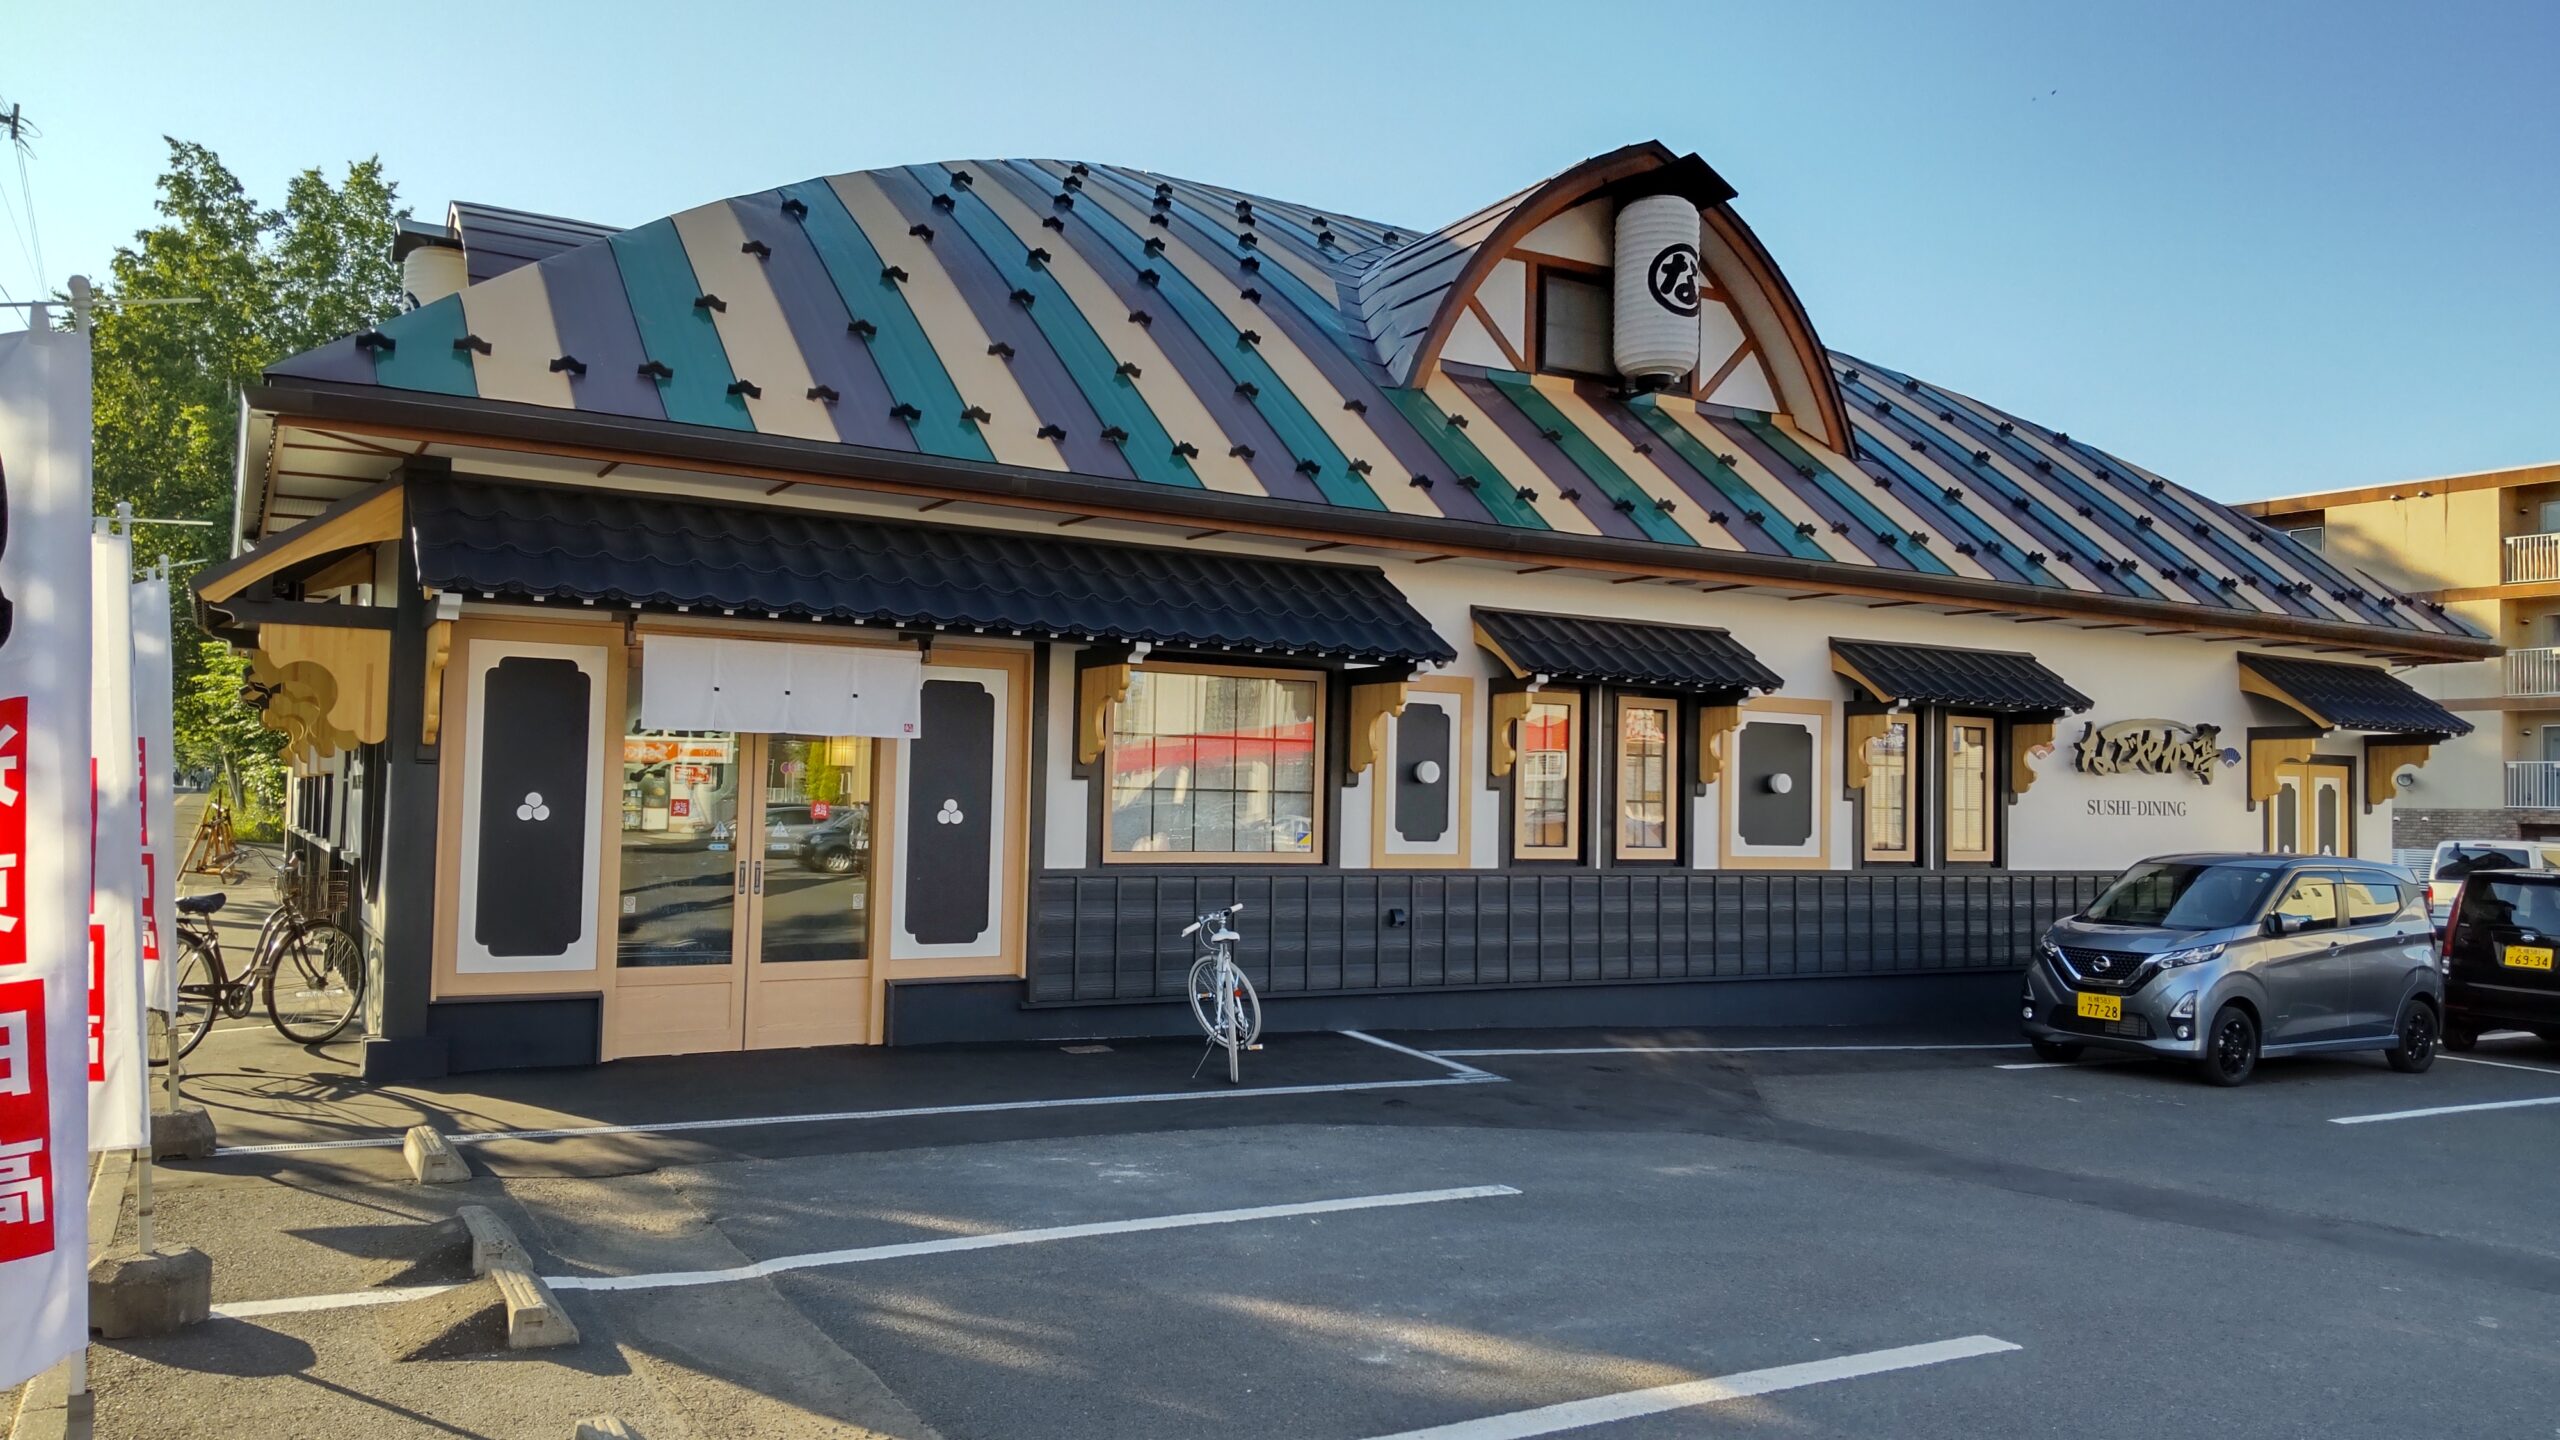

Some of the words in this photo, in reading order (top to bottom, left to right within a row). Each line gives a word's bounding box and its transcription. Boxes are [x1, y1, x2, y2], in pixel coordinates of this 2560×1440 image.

[1659, 252, 1700, 306] な
[2073, 719, 2222, 785] なごやか亭
[2086, 799, 2187, 817] SUSHI-DINING
[2514, 955, 2548, 967] 69-34
[2087, 1004, 2118, 1018] 77-28
